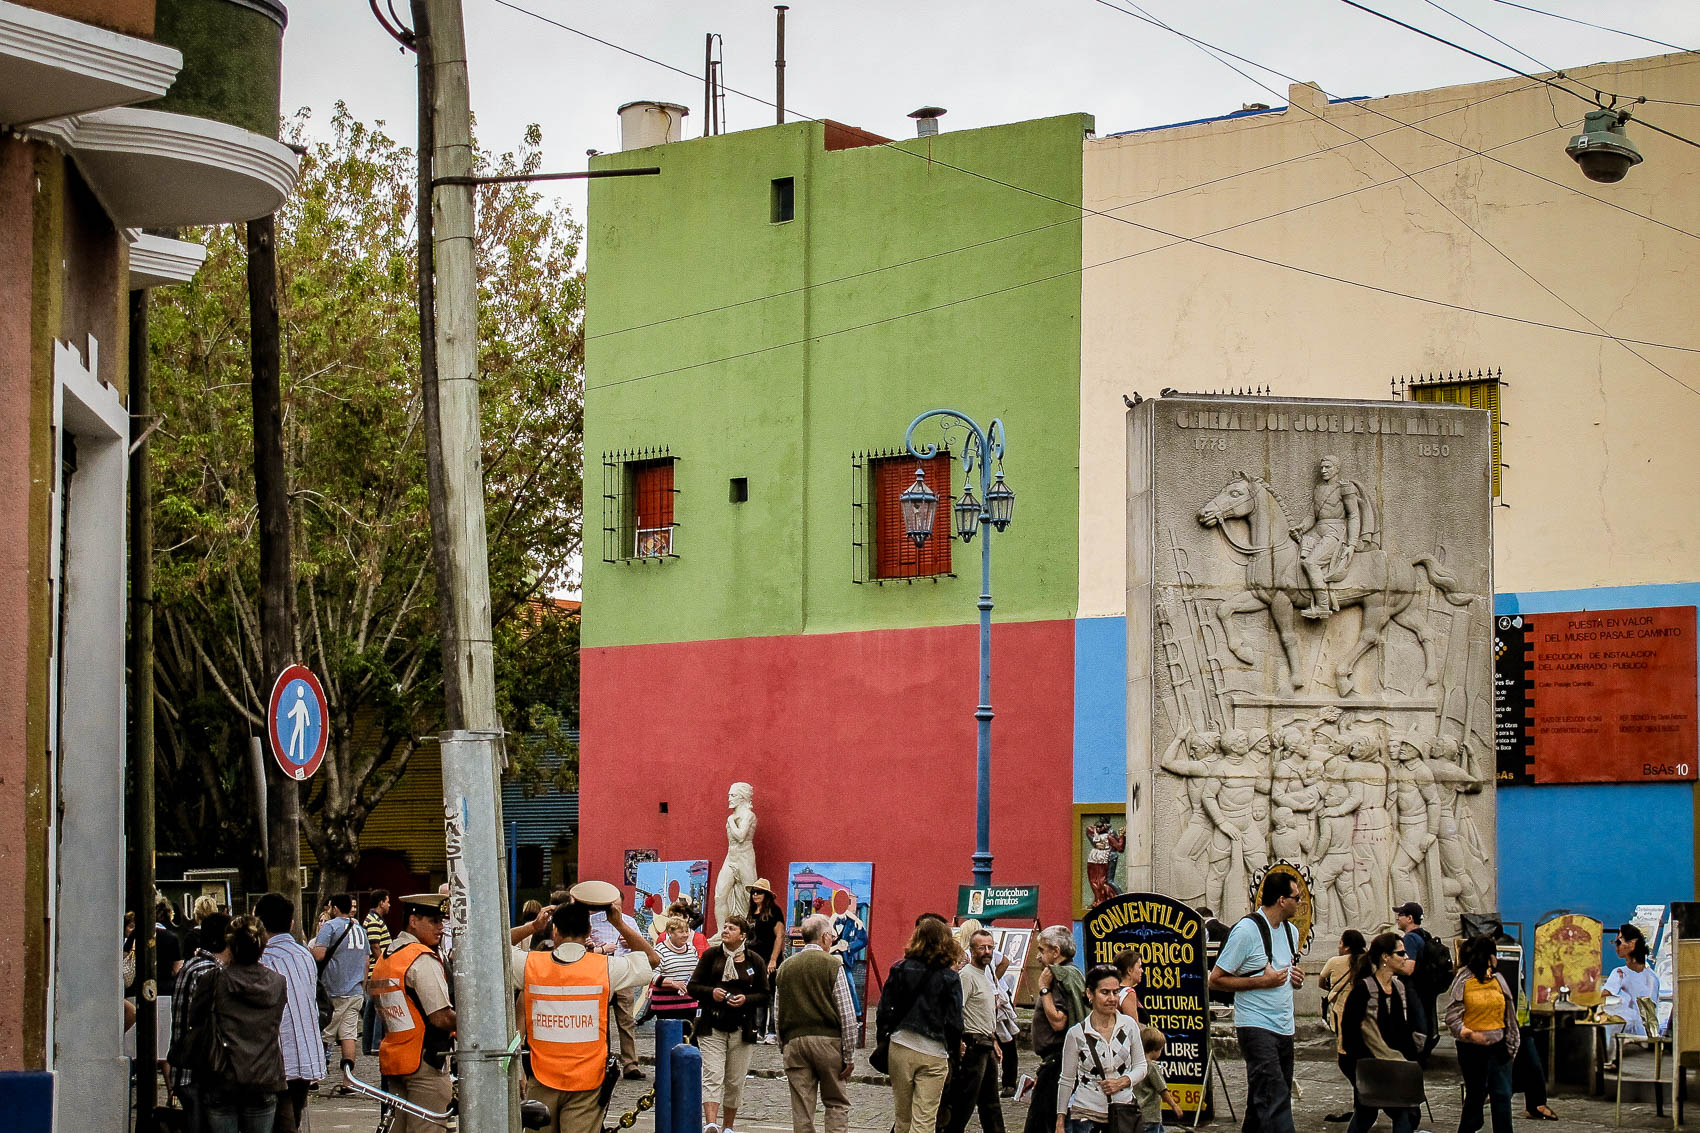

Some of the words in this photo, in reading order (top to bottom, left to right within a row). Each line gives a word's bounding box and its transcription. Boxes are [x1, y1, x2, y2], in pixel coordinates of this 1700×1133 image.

[1176, 411, 1250, 430] GENERAL
[1256, 413, 1288, 431] DON
[1294, 414, 1338, 433] JOSE
[1343, 415, 1363, 433] DE
[1368, 416, 1400, 435] SAN
[1406, 418, 1464, 437] MARTIN
[1194, 437, 1227, 451] 1778
[1419, 443, 1450, 457] 1850
[1568, 619, 1603, 629] PUESTA
[1607, 618, 1619, 628] EN
[1622, 616, 1653, 626] VALOR
[1545, 633, 1560, 642] DEL
[1565, 632, 1597, 641] MUSEO
[1600, 630, 1634, 640] PASAJE
[1638, 628, 1681, 638] CAMINITO
[1603, 651, 1656, 659] INSTALACION
[1556, 662, 1608, 670] ALUMBRADO
[1643, 763, 1675, 776] BsAs
[1676, 763, 1689, 776] 10
[987, 888, 995, 897] Tu
[995, 888, 1029, 897] caricatura
[985, 898, 994, 906] en
[994, 897, 1019, 906] minutos
[1090, 901, 1198, 939] CONVENTILLO
[347, 924, 365, 949] 10
[1145, 966, 1181, 989] 1881
[1144, 995, 1203, 1011] CULTURAL
[536, 1013, 594, 1029] PREFECTURA
[1147, 1014, 1204, 1030] RTISTAS
[1164, 1042, 1199, 1060] LIBRE
